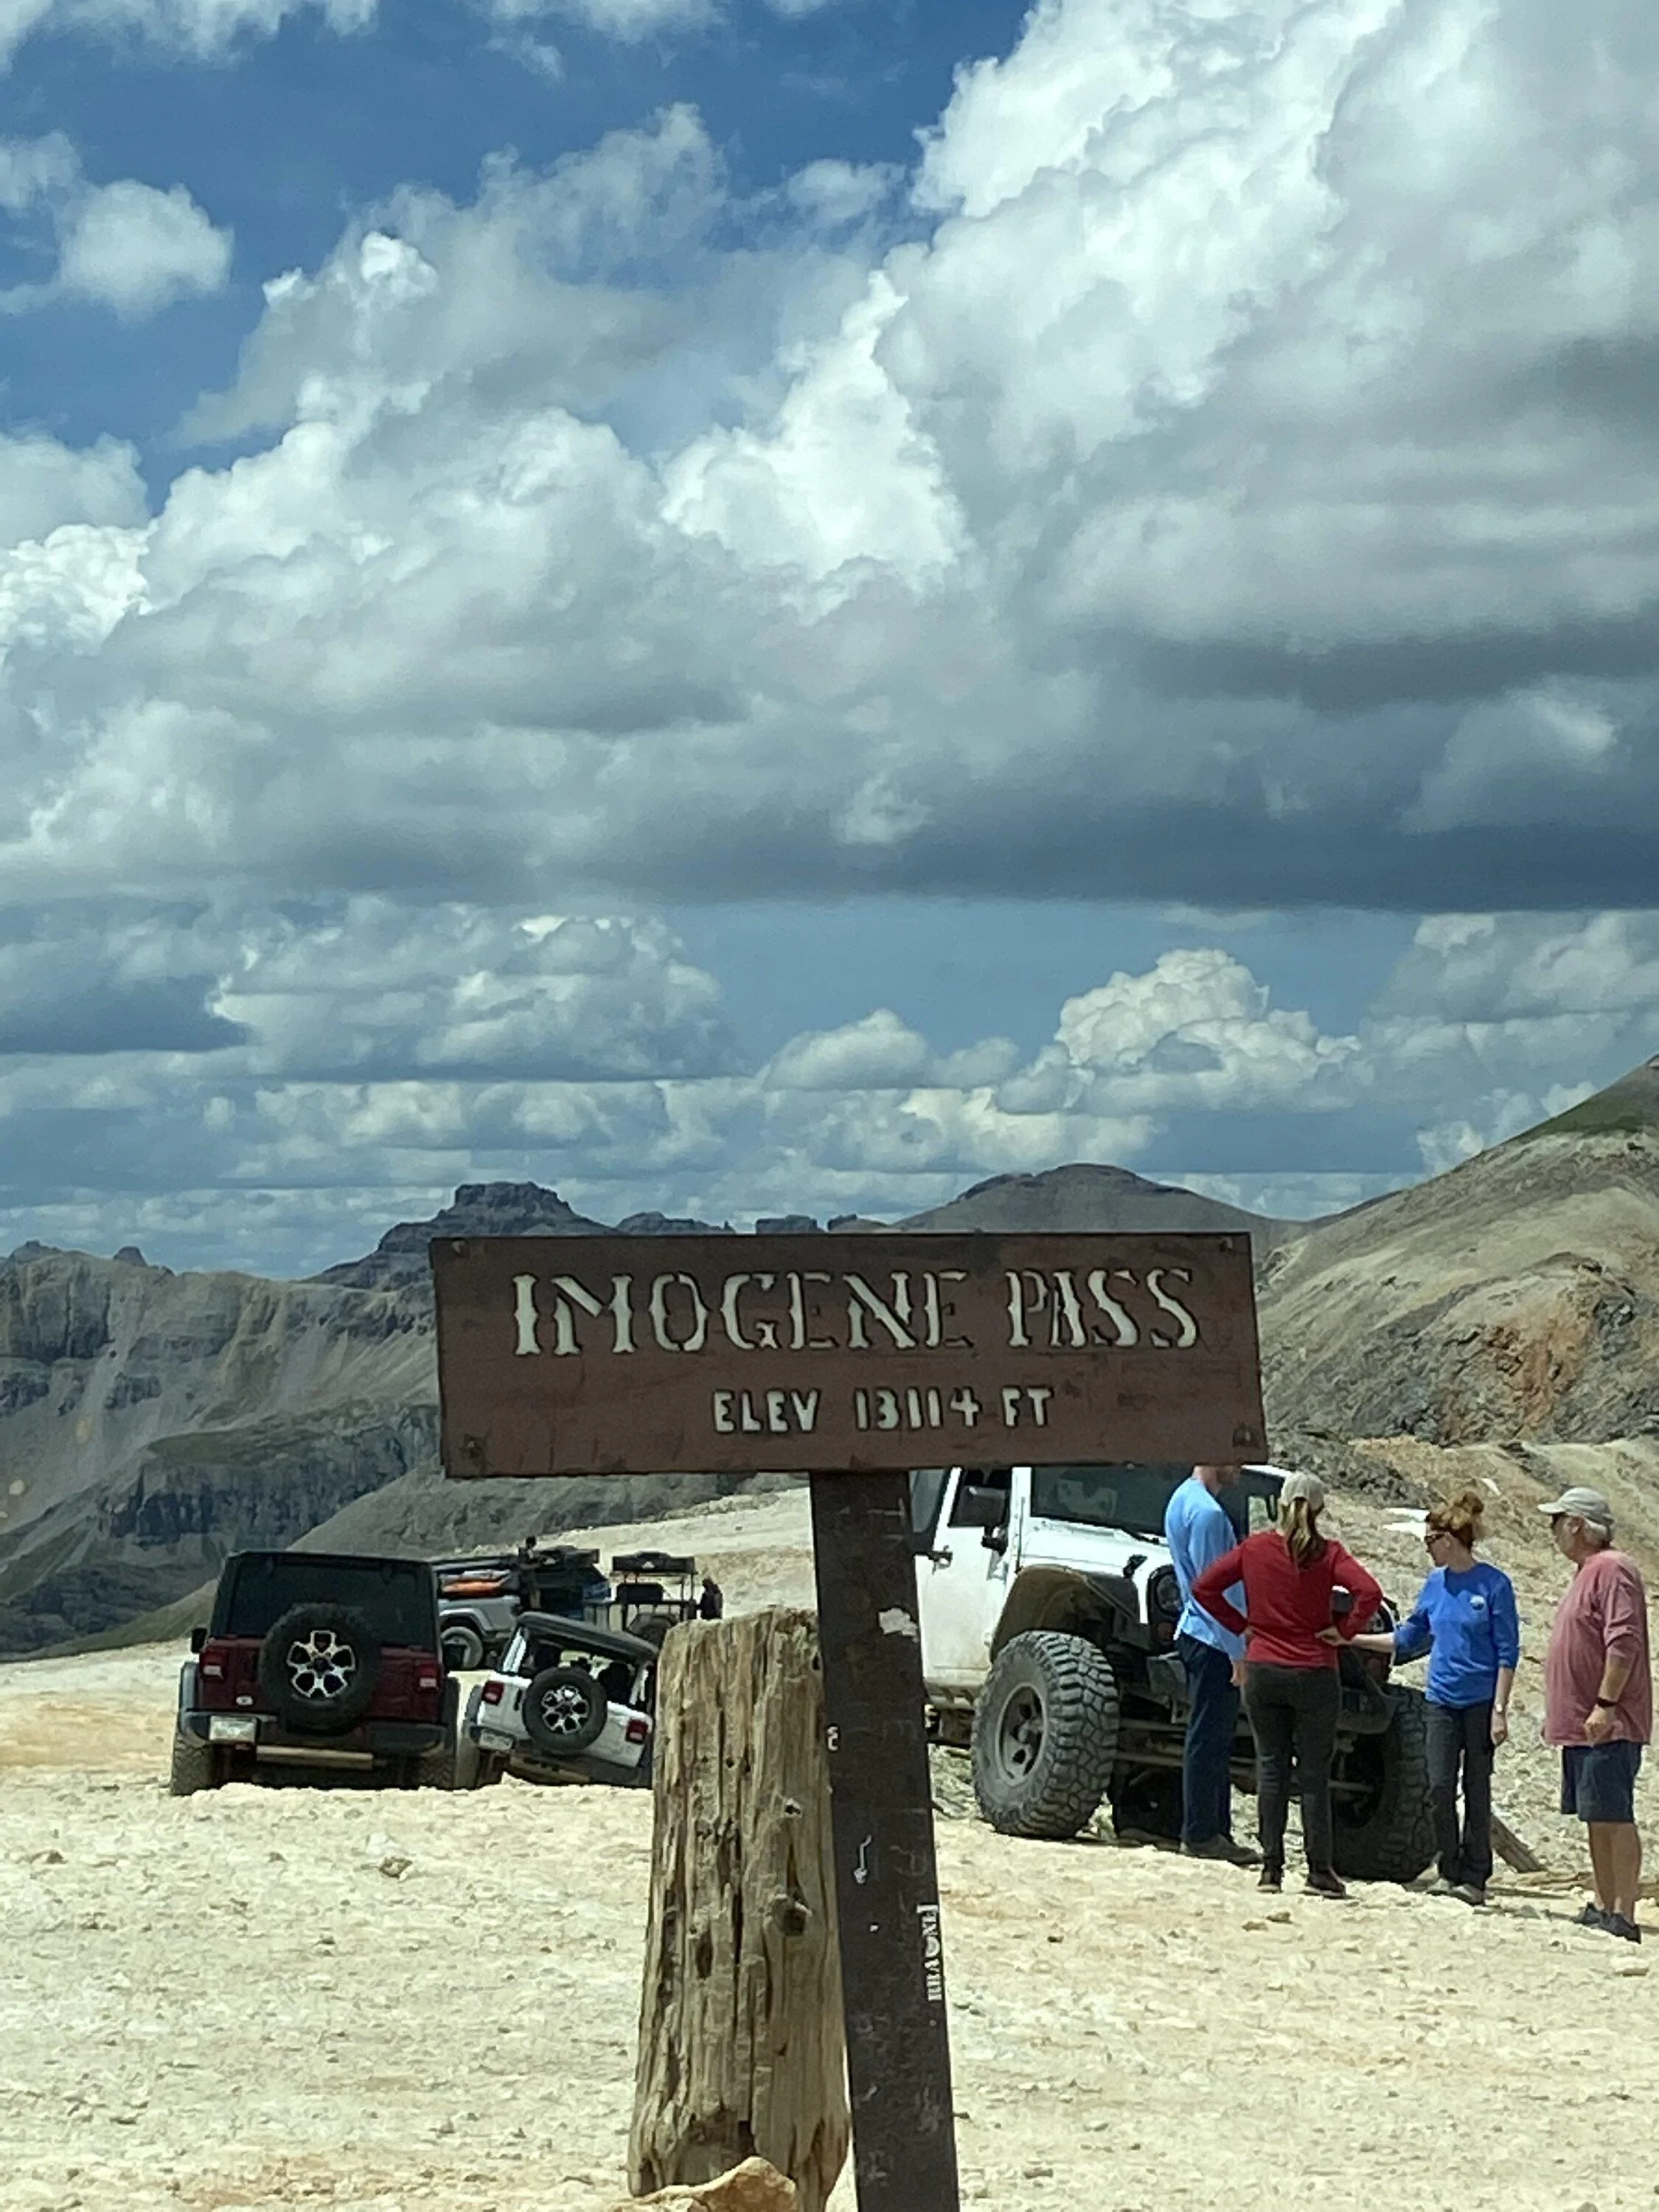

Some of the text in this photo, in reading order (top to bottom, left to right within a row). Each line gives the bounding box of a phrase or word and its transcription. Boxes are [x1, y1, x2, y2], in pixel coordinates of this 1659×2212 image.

[511, 1268, 1199, 1355] IMOGENE PASS
[712, 1387, 1052, 1433] ELEV 13114 FT
